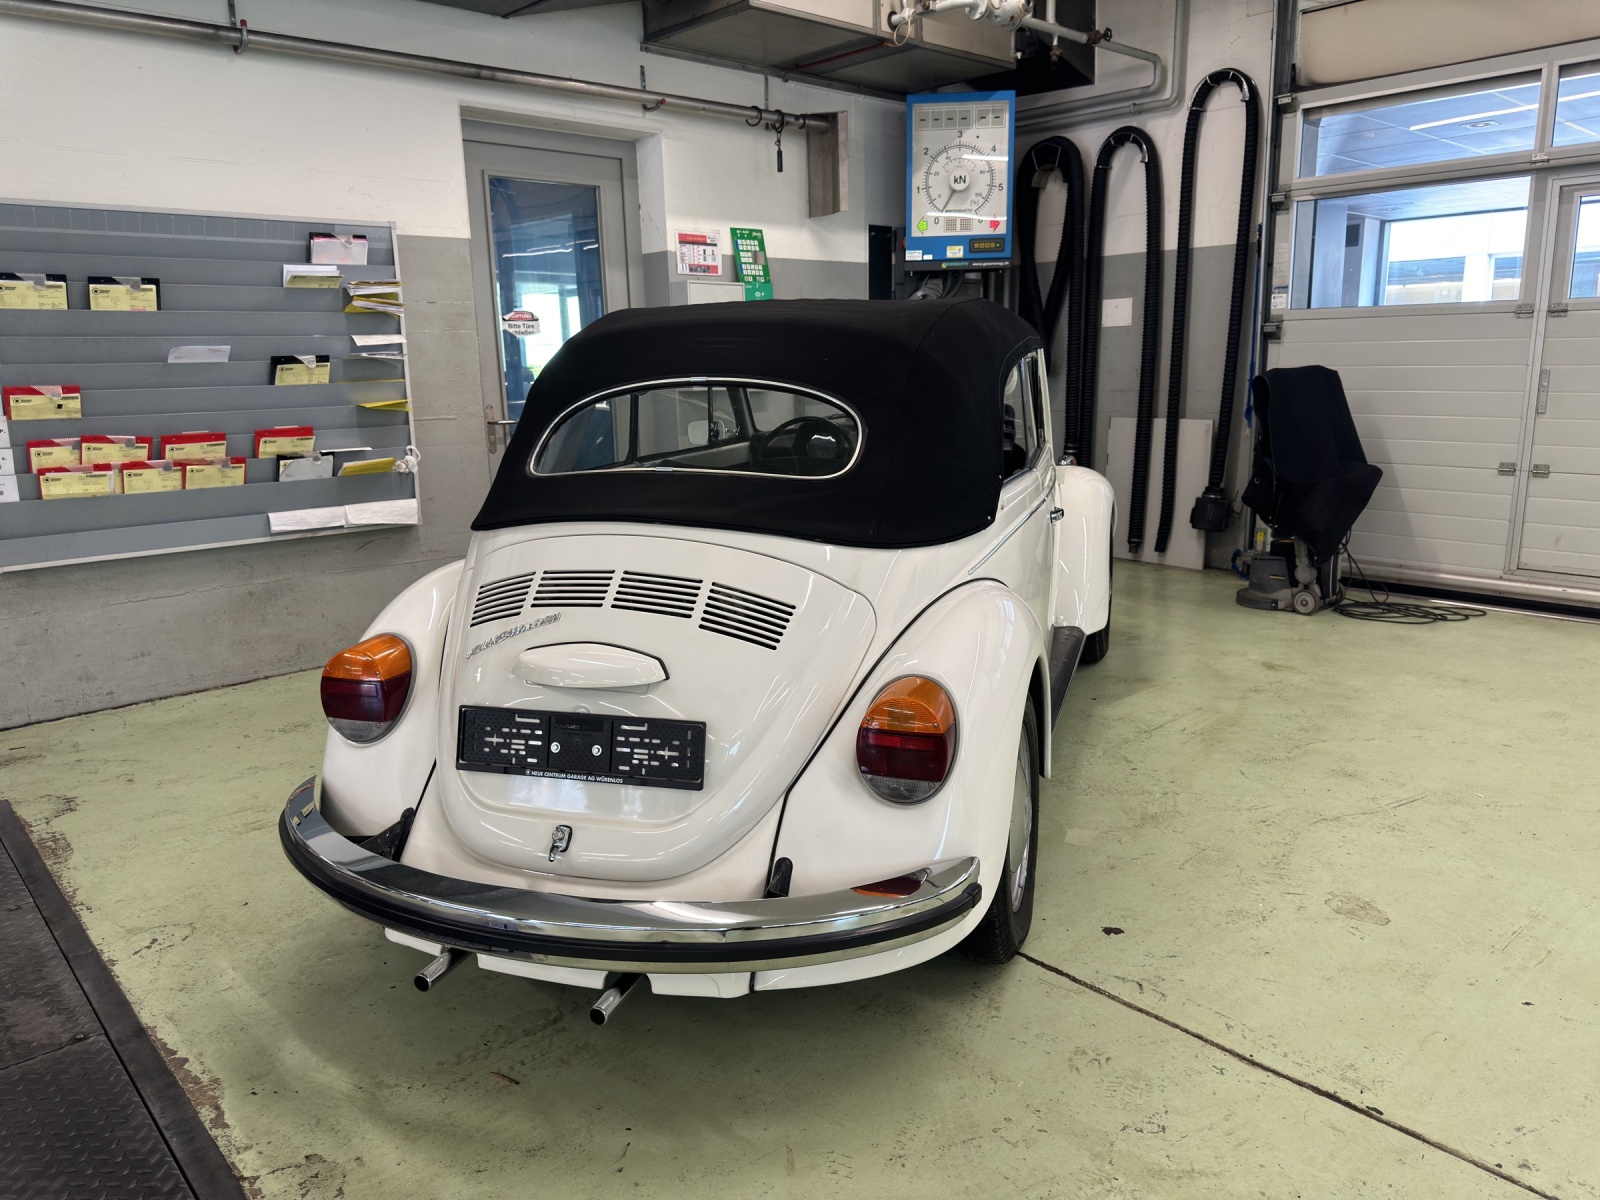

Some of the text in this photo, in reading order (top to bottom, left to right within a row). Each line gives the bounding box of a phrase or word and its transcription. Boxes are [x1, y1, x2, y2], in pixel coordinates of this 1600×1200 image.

[957, 130, 963, 139] 3
[923, 147, 929, 156] 2
[991, 144, 997, 153] 4
[953, 175, 967, 184] kN
[998, 183, 1004, 192] 5
[934, 216, 940, 225] 0
[596, 776, 624, 784] WÜRENLOS
